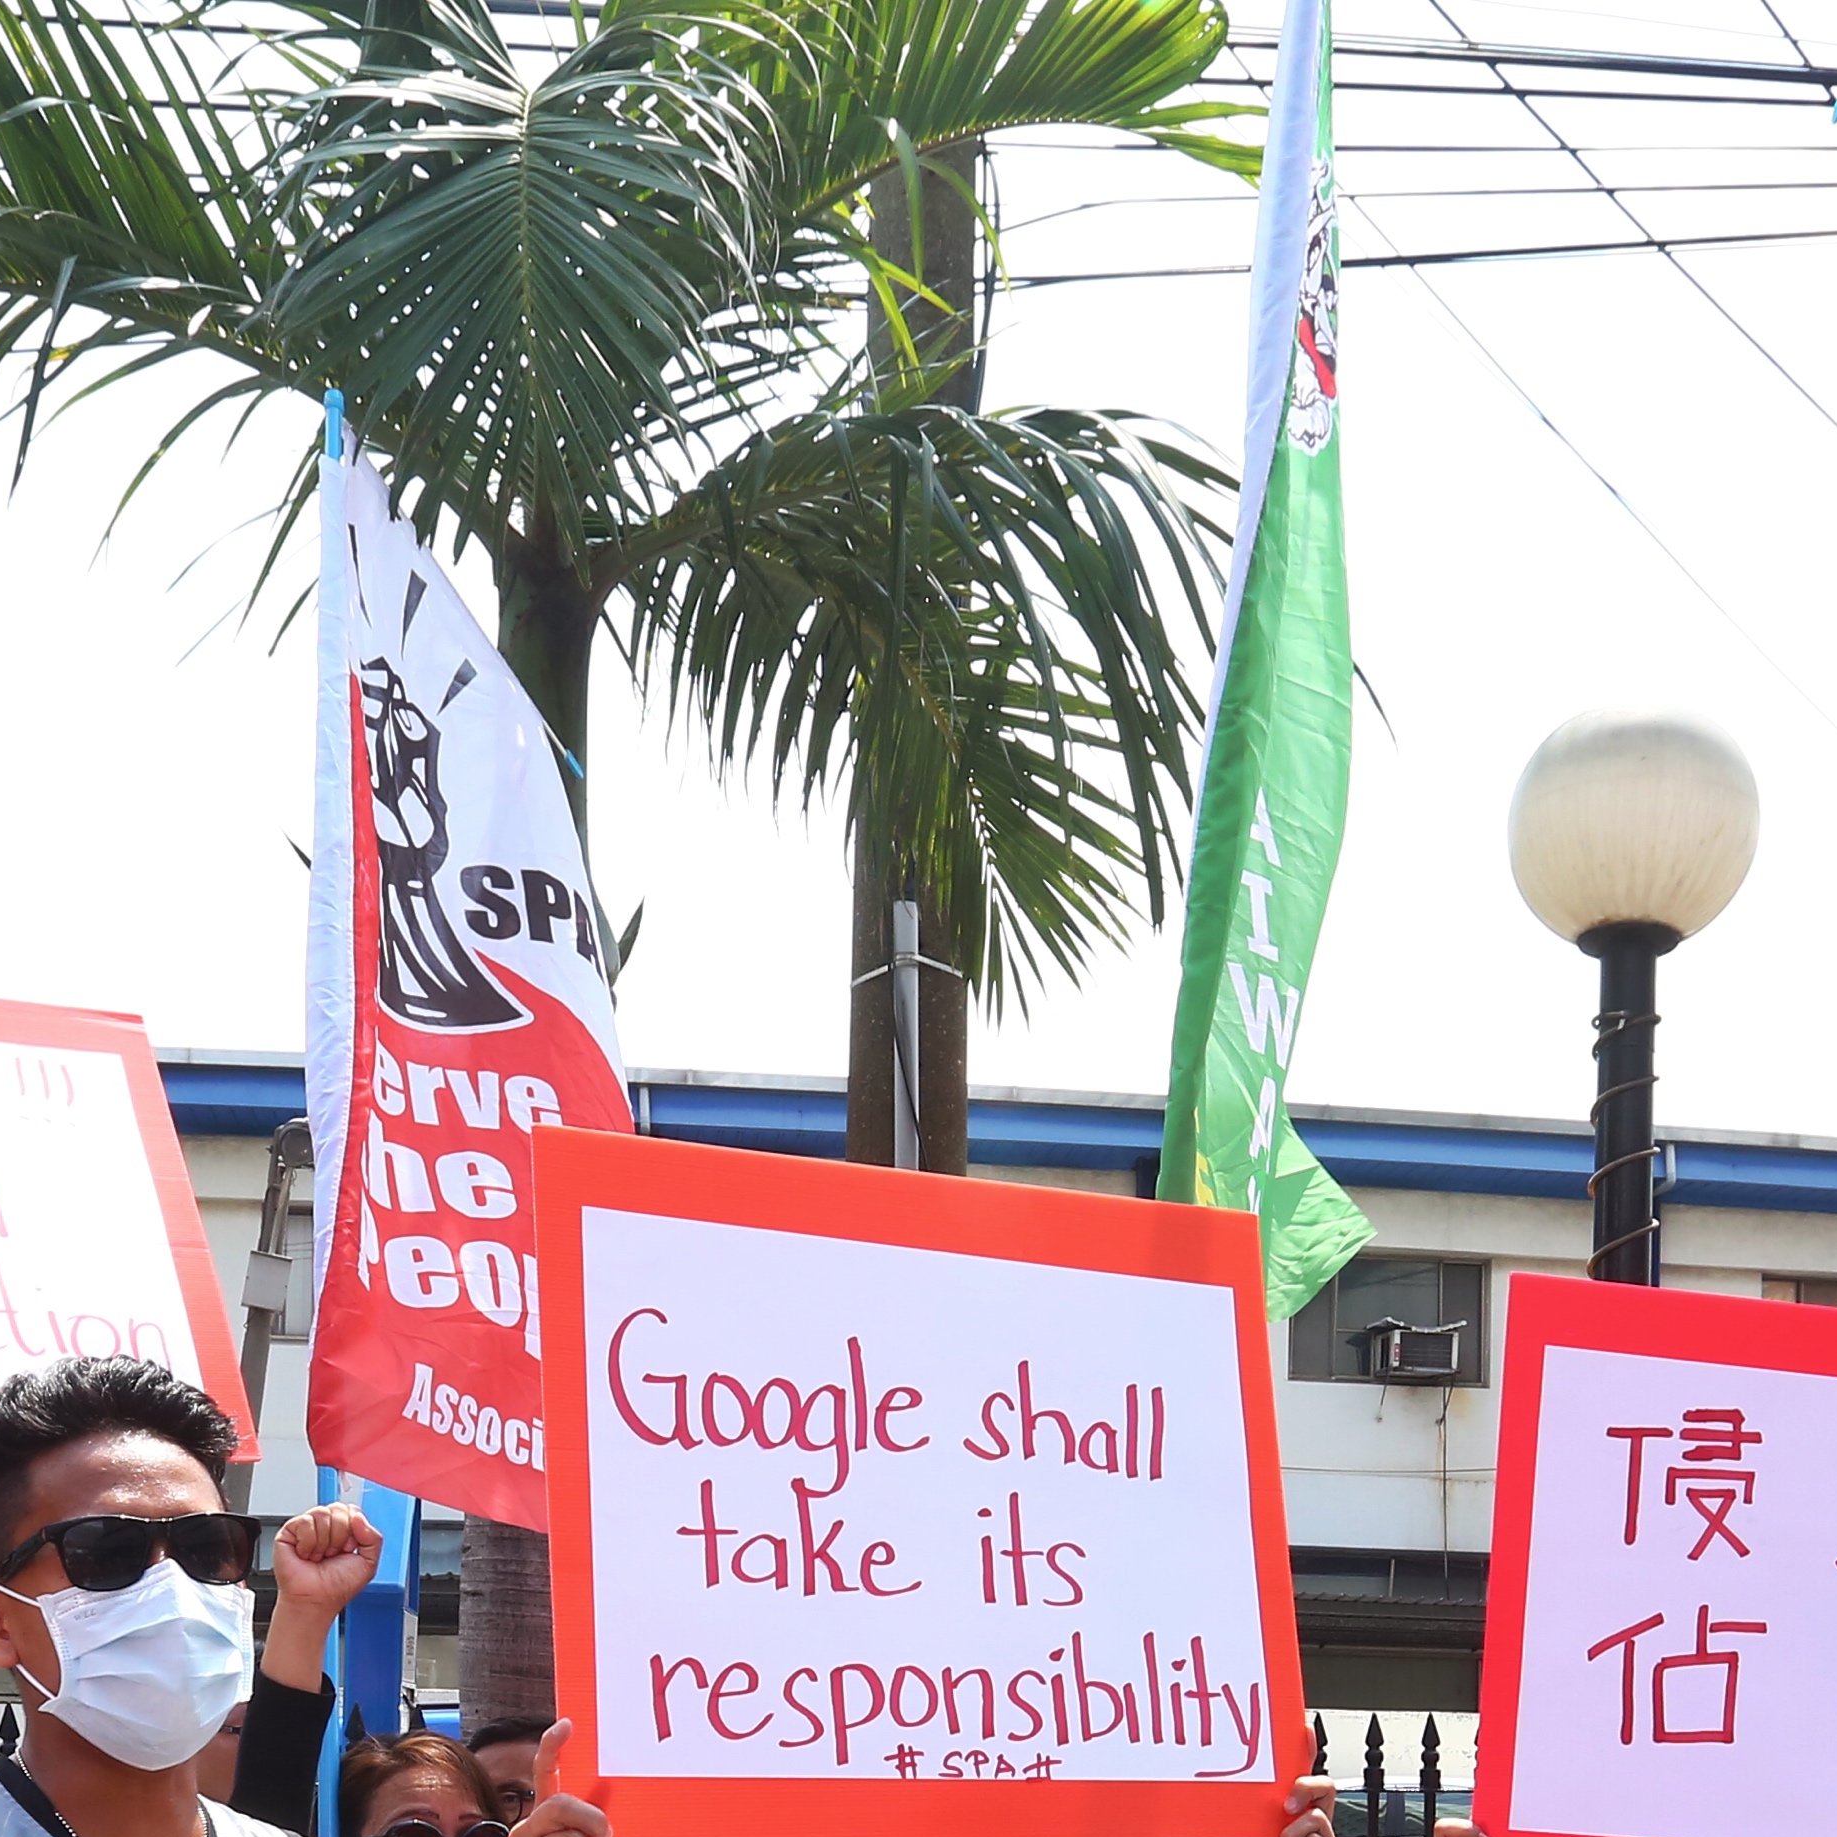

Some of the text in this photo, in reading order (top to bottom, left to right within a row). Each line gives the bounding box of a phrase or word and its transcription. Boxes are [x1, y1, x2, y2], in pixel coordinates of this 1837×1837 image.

[374, 1038, 563, 1138] erve
[364, 1108, 518, 1219] he
[606, 1307, 1165, 1498] Google shall
[676, 1476, 1087, 1608] take its
[648, 1631, 1262, 1779] responsibility
